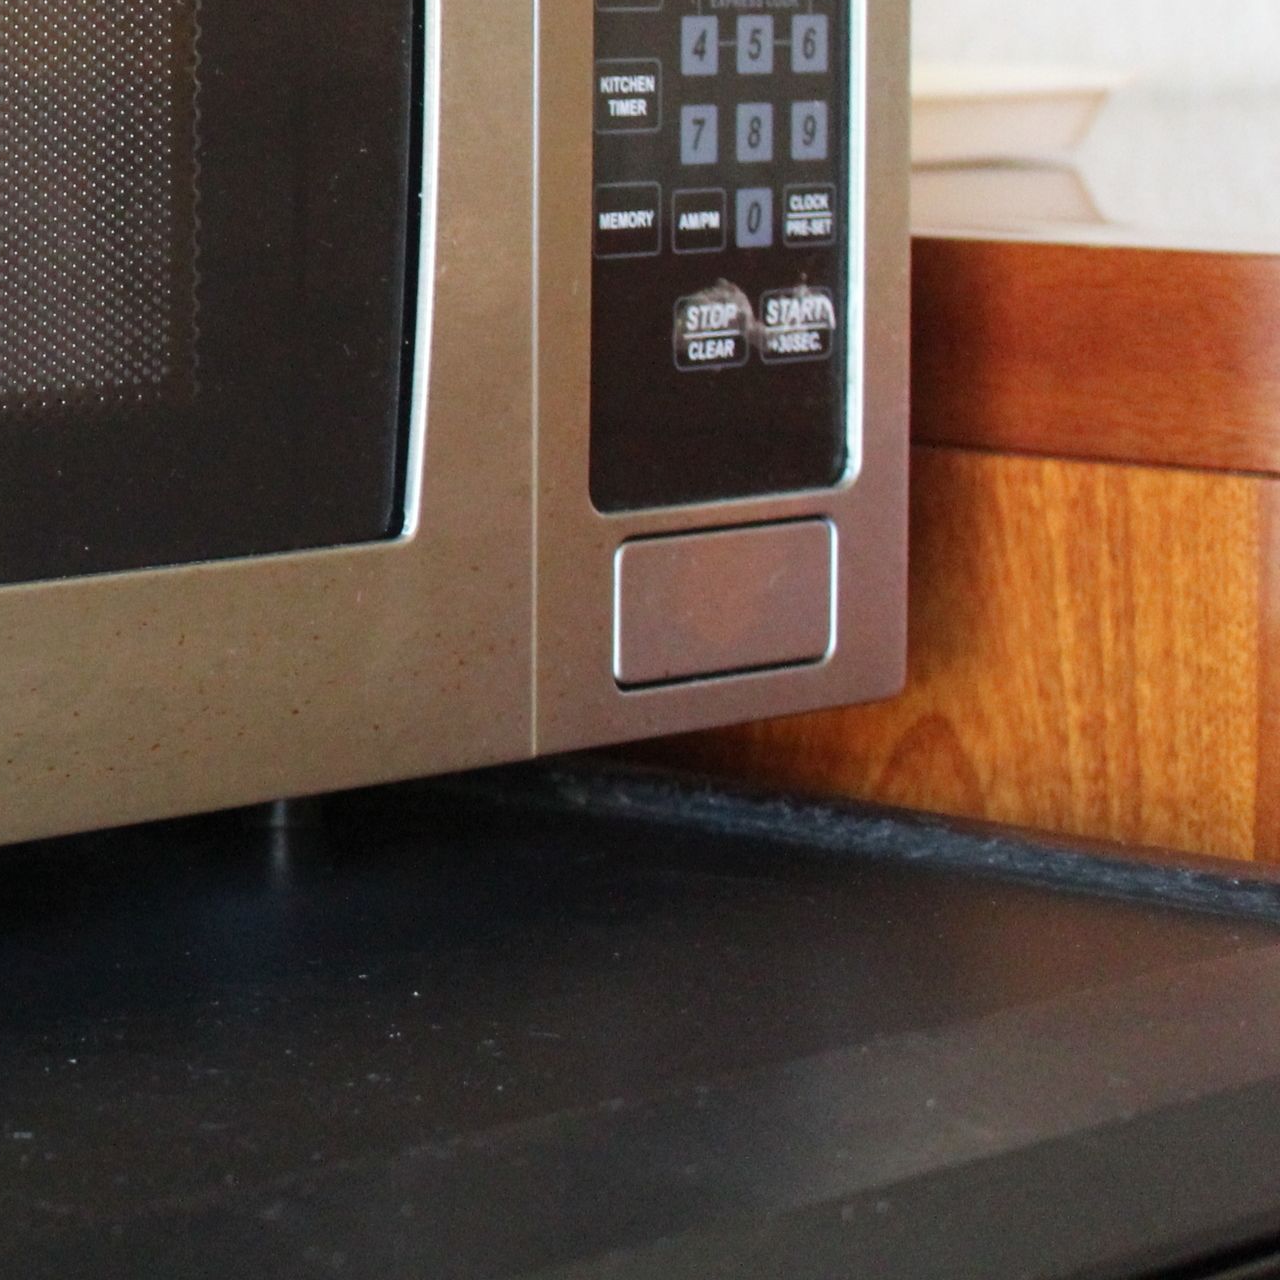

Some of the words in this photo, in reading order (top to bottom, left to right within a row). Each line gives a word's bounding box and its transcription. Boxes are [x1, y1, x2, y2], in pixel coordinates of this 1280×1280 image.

[692, 29, 707, 61] 4
[747, 28, 762, 60] 5
[802, 27, 817, 60] 6
[600, 75, 655, 93] KITCHEN
[608, 99, 647, 117] TIMER
[692, 118, 706, 151] 7
[747, 116, 762, 149] 8
[802, 114, 817, 146] 9
[790, 193, 829, 211] CLOCK
[599, 210, 655, 230] MEMORY
[686, 302, 738, 331] STOP
[766, 296, 827, 325] START
[688, 339, 735, 361] CLEAR
